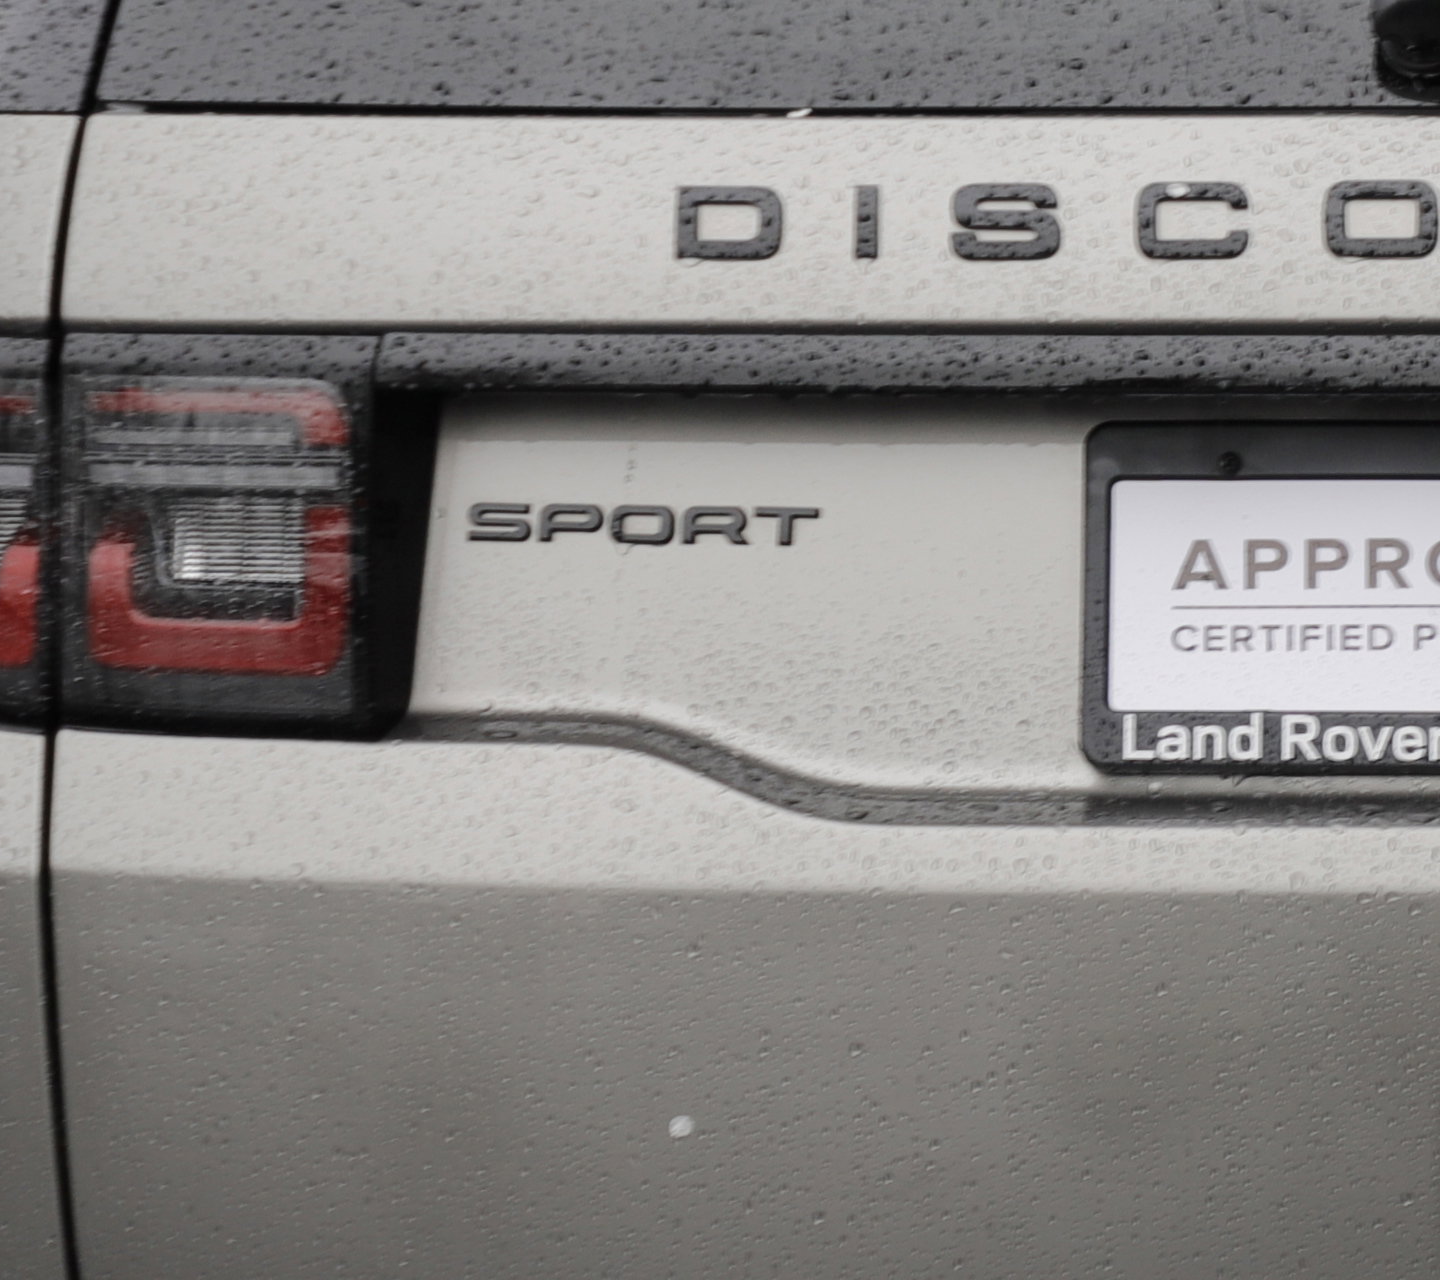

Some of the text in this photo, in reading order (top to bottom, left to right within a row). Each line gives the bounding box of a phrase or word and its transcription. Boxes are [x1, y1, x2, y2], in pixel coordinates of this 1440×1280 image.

[466, 502, 820, 546] SPORT
[1171, 624, 1394, 653] CERTIFIED
[1121, 713, 1264, 763] Land
